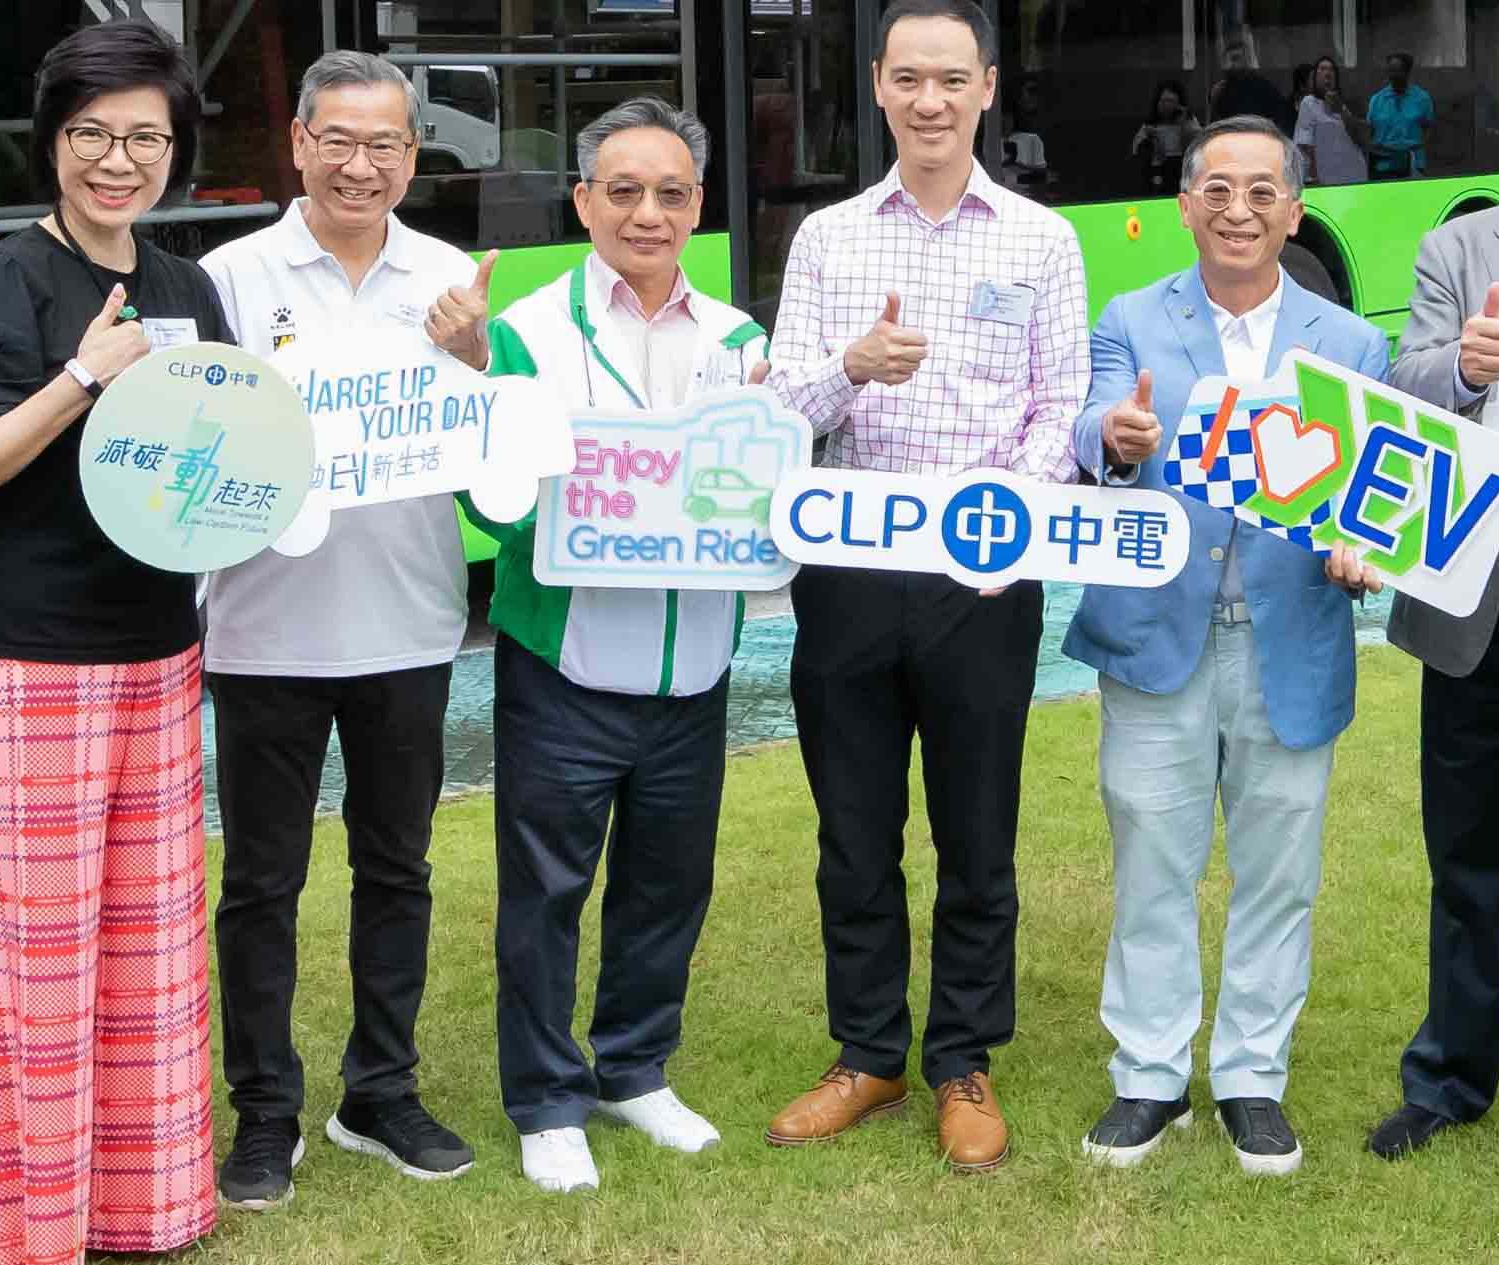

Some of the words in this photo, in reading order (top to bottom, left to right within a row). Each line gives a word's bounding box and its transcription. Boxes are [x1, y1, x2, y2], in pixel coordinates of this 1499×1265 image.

[168, 361, 203, 379] CLP
[297, 369, 392, 415] HARGE
[400, 364, 436, 401] UP
[360, 400, 433, 444] YOUR
[442, 391, 497, 461] DAY
[570, 439, 682, 486] Enjoy
[565, 480, 637, 519] the
[566, 524, 684, 563] Green
[694, 528, 778, 565] Ride
[789, 488, 928, 548] CLP
[1048, 504, 1169, 570] 中電
